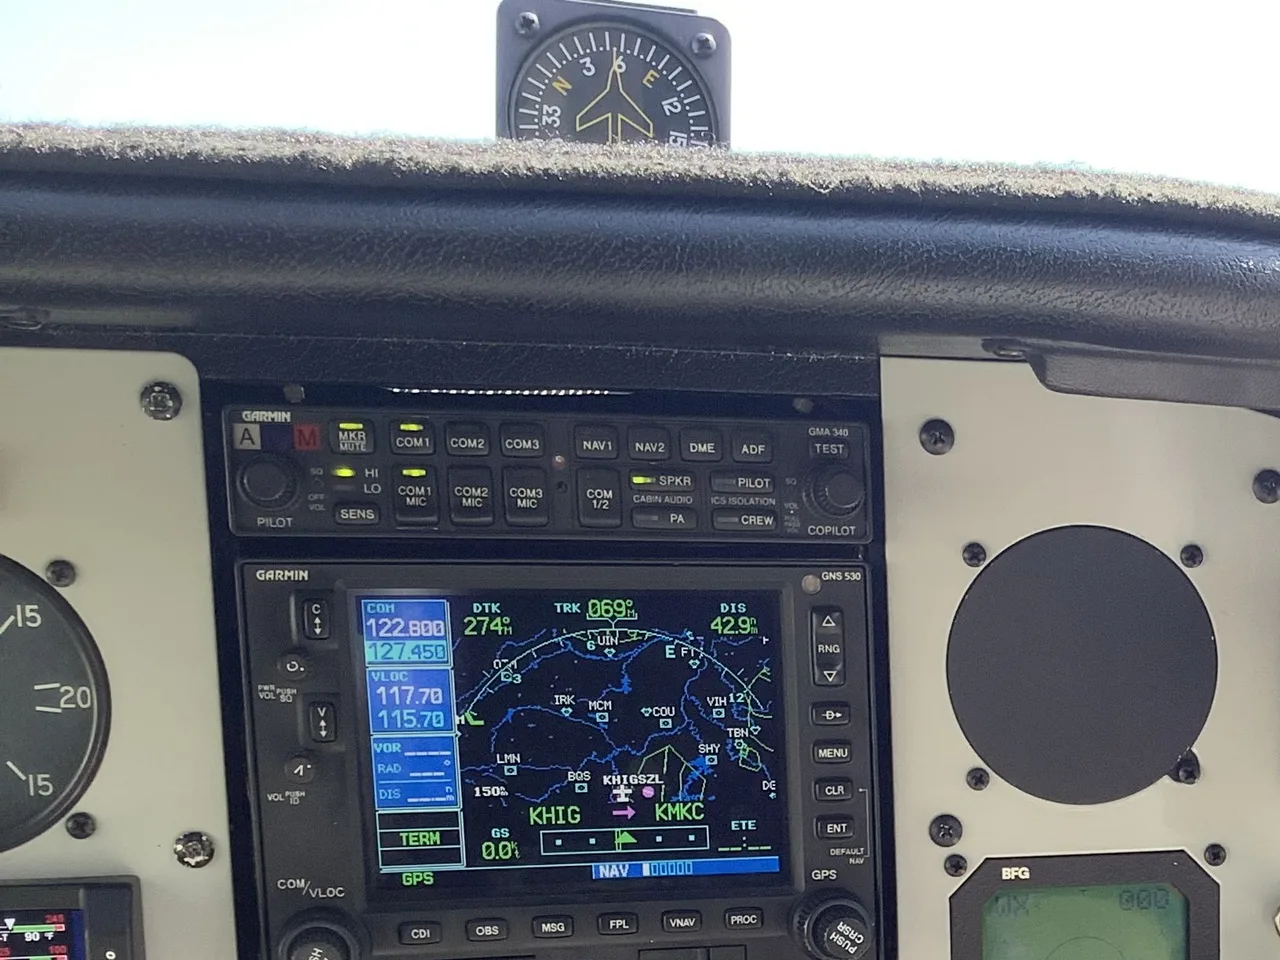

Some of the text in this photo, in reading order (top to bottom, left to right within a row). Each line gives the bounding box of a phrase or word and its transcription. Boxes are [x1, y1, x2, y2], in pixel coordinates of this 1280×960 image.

[579, 57, 595, 76] 3
[642, 69, 660, 88] E
[661, 97, 681, 116] 12
[542, 105, 561, 127] 33
[242, 411, 291, 423] GARMIN
[396, 437, 430, 448] COM1
[450, 438, 485, 449] COM2
[505, 438, 540, 449] COM3
[583, 441, 612, 450] NAV1
[635, 443, 665, 453] NAV2
[690, 443, 715, 453] DME
[741, 445, 765, 454] ADF
[815, 444, 844, 454] TEST
[659, 476, 691, 486] SPKR
[738, 478, 771, 489] PILOT
[340, 509, 375, 519] SENS
[670, 514, 685, 523] PA
[257, 517, 293, 527] PILOT
[741, 515, 774, 525] CREW
[808, 526, 856, 536] COPILOT
[256, 570, 308, 581] GARMIN
[473, 603, 500, 614] DTK
[554, 603, 581, 613] TRK
[720, 603, 746, 613] DIS
[17, 605, 42, 627] 15
[366, 618, 445, 637] 122.800
[368, 642, 446, 660] 127.450
[818, 644, 840, 654] RNG
[60, 686, 91, 708] 20
[376, 686, 443, 705] 117.70
[819, 748, 848, 758] MENU
[29, 774, 53, 796] 15
[825, 786, 844, 796] CLR
[530, 806, 580, 825] KHIG
[655, 803, 705, 821] KMKC
[827, 823, 847, 833] ENT
[400, 832, 441, 846] TERM
[402, 872, 434, 885] GPS
[812, 869, 837, 881] GPS
[1002, 867, 1030, 879] BFG
[610, 920, 629, 929] FPL
[670, 917, 695, 928] VNAV
[731, 914, 757, 924] PROC
[476, 926, 499, 936] OBS
[542, 922, 564, 932] MSG
[411, 928, 430, 938] CDI
